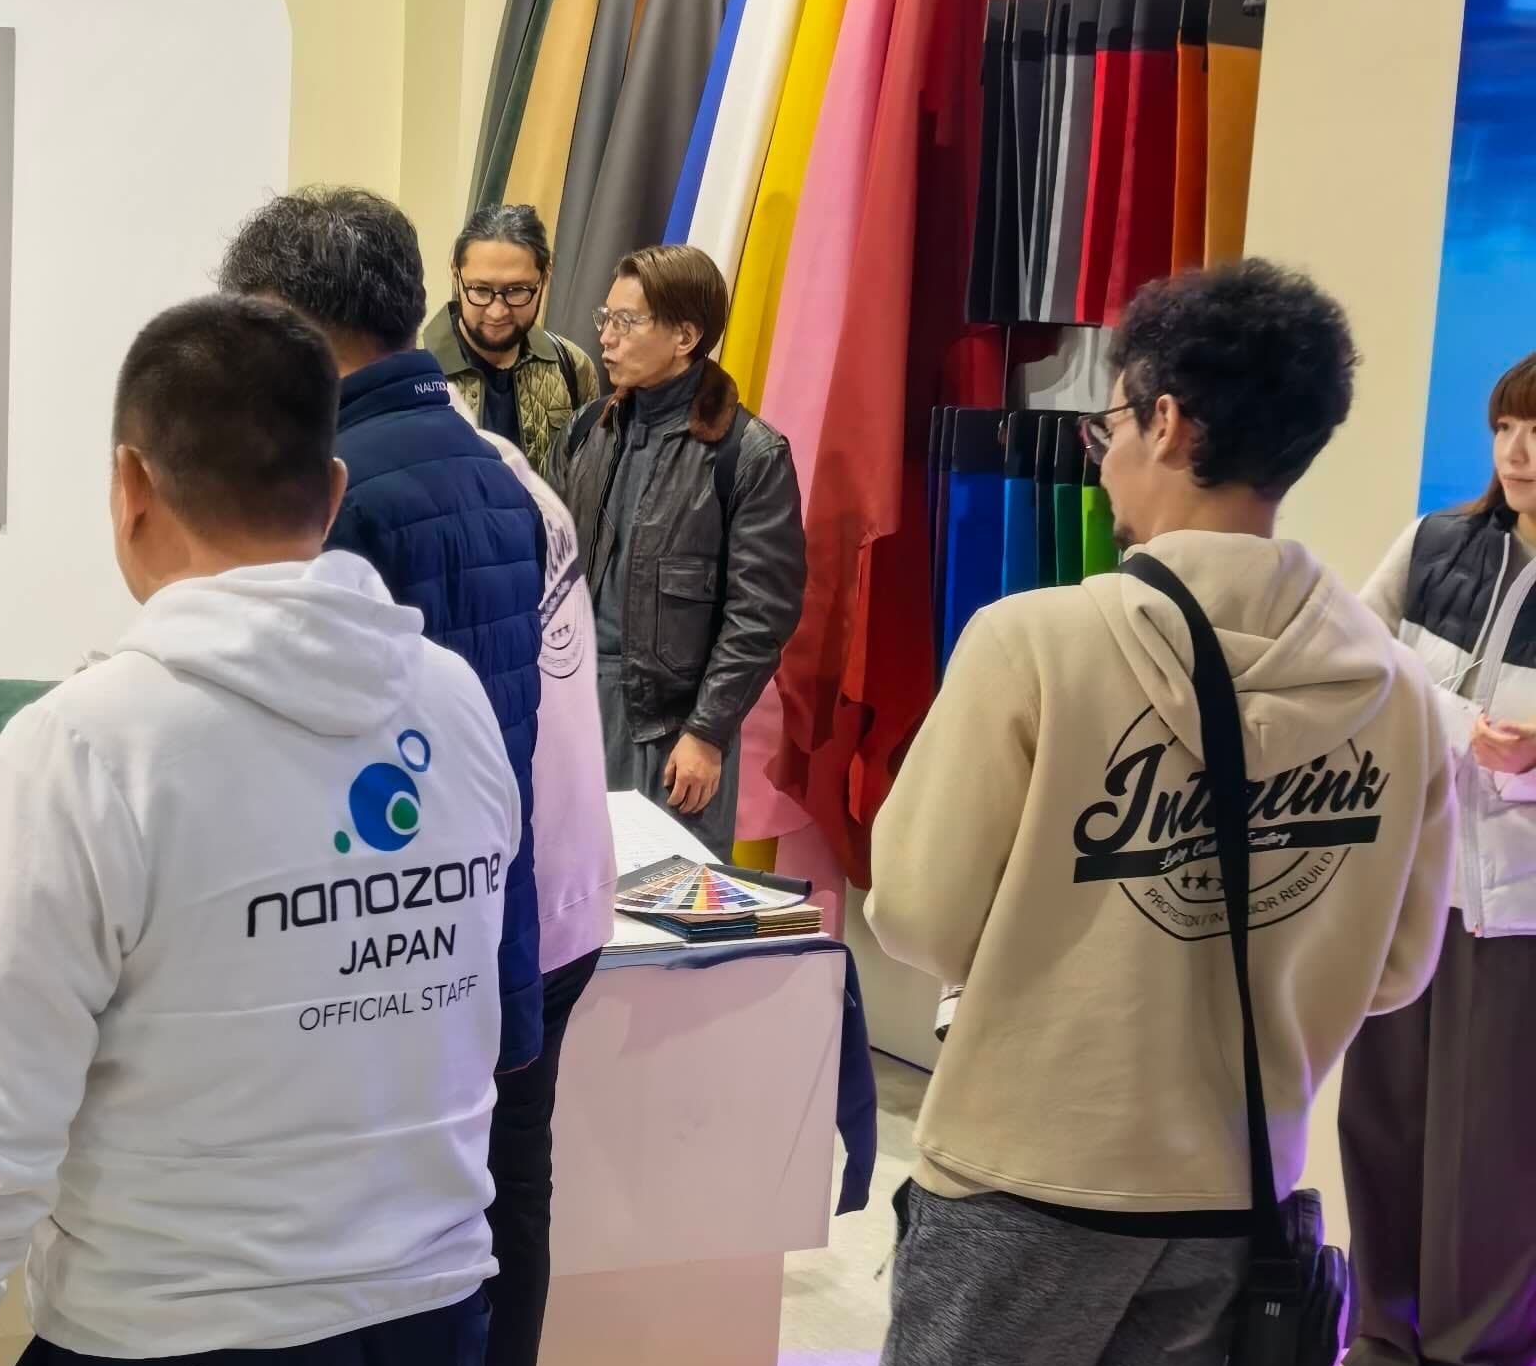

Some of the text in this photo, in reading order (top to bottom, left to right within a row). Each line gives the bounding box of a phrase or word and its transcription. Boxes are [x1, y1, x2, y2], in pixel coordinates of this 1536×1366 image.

[247, 852, 501, 938] nanozone
[1279, 851, 1335, 901] REBUILD
[339, 923, 457, 976] JAPAN
[298, 974, 478, 1031] OFFICIAL STAFF
